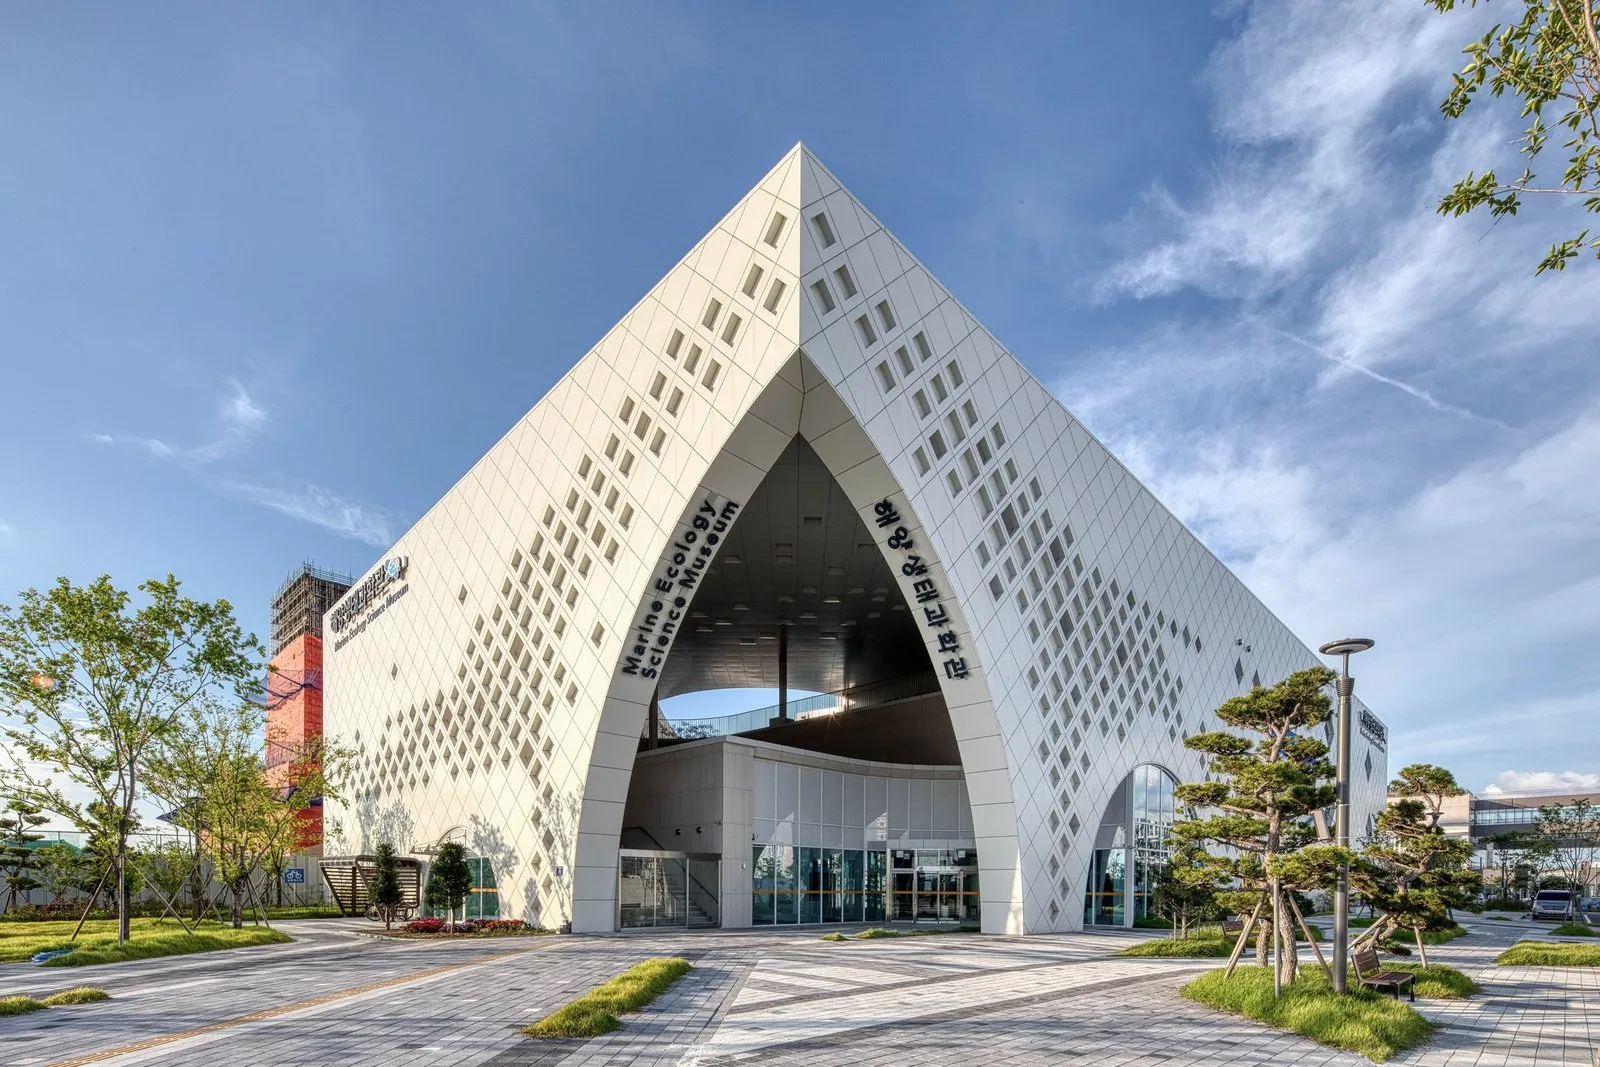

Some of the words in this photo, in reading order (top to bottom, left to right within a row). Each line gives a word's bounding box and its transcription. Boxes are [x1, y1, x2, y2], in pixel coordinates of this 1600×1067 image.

[349, 619, 367, 641] Ecology
[367, 603, 385, 625] Science
[385, 583, 409, 609] Museum
[622, 600, 663, 676] Marine
[655, 499, 717, 594] Ecology
[641, 596, 687, 680] Science
[679, 501, 740, 590] Museum
[874, 498, 969, 680] 해양생태과학관
